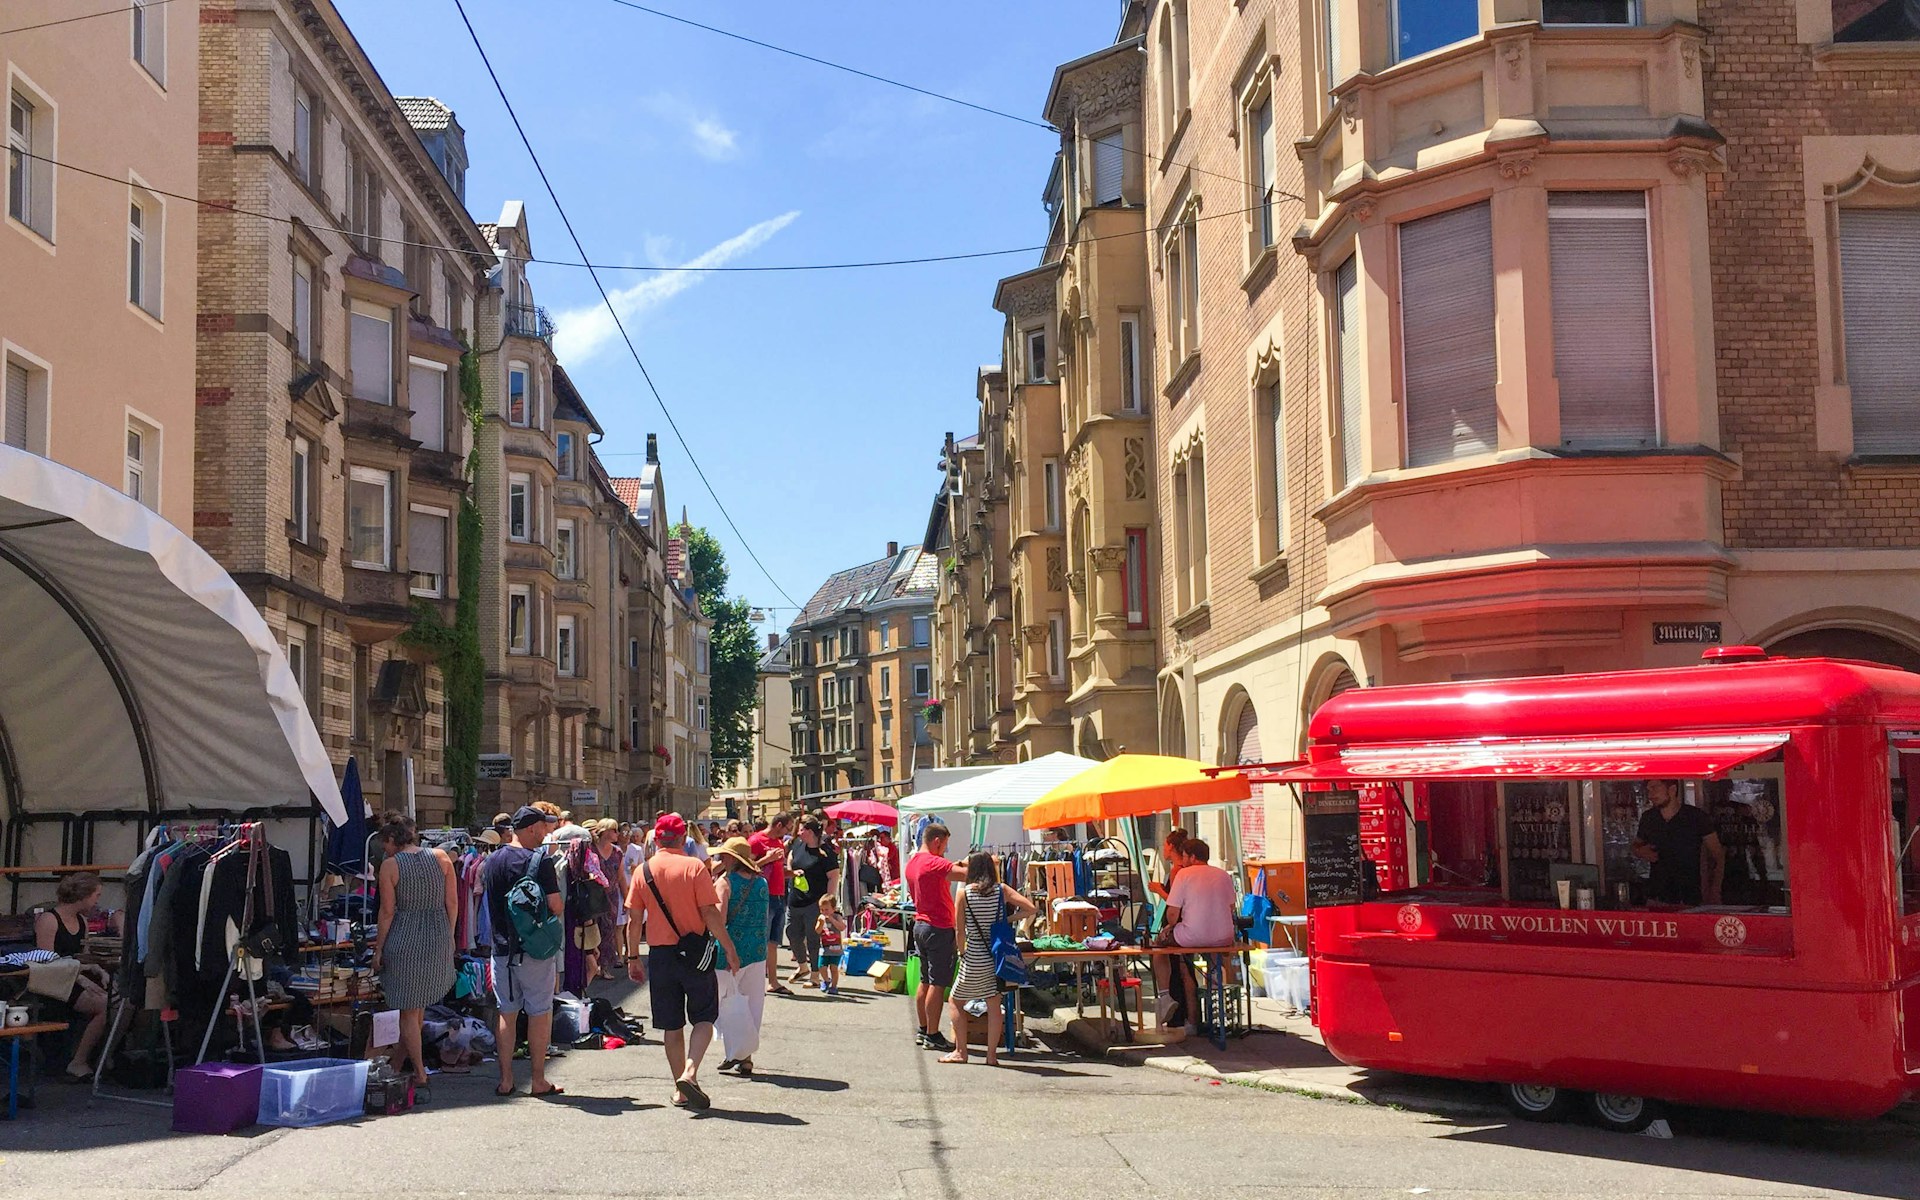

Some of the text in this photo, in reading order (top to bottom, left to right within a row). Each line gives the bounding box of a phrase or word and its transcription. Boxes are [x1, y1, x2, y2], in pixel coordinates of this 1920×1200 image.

[1451, 913, 1679, 939] WIR WOLLEN WULLE
